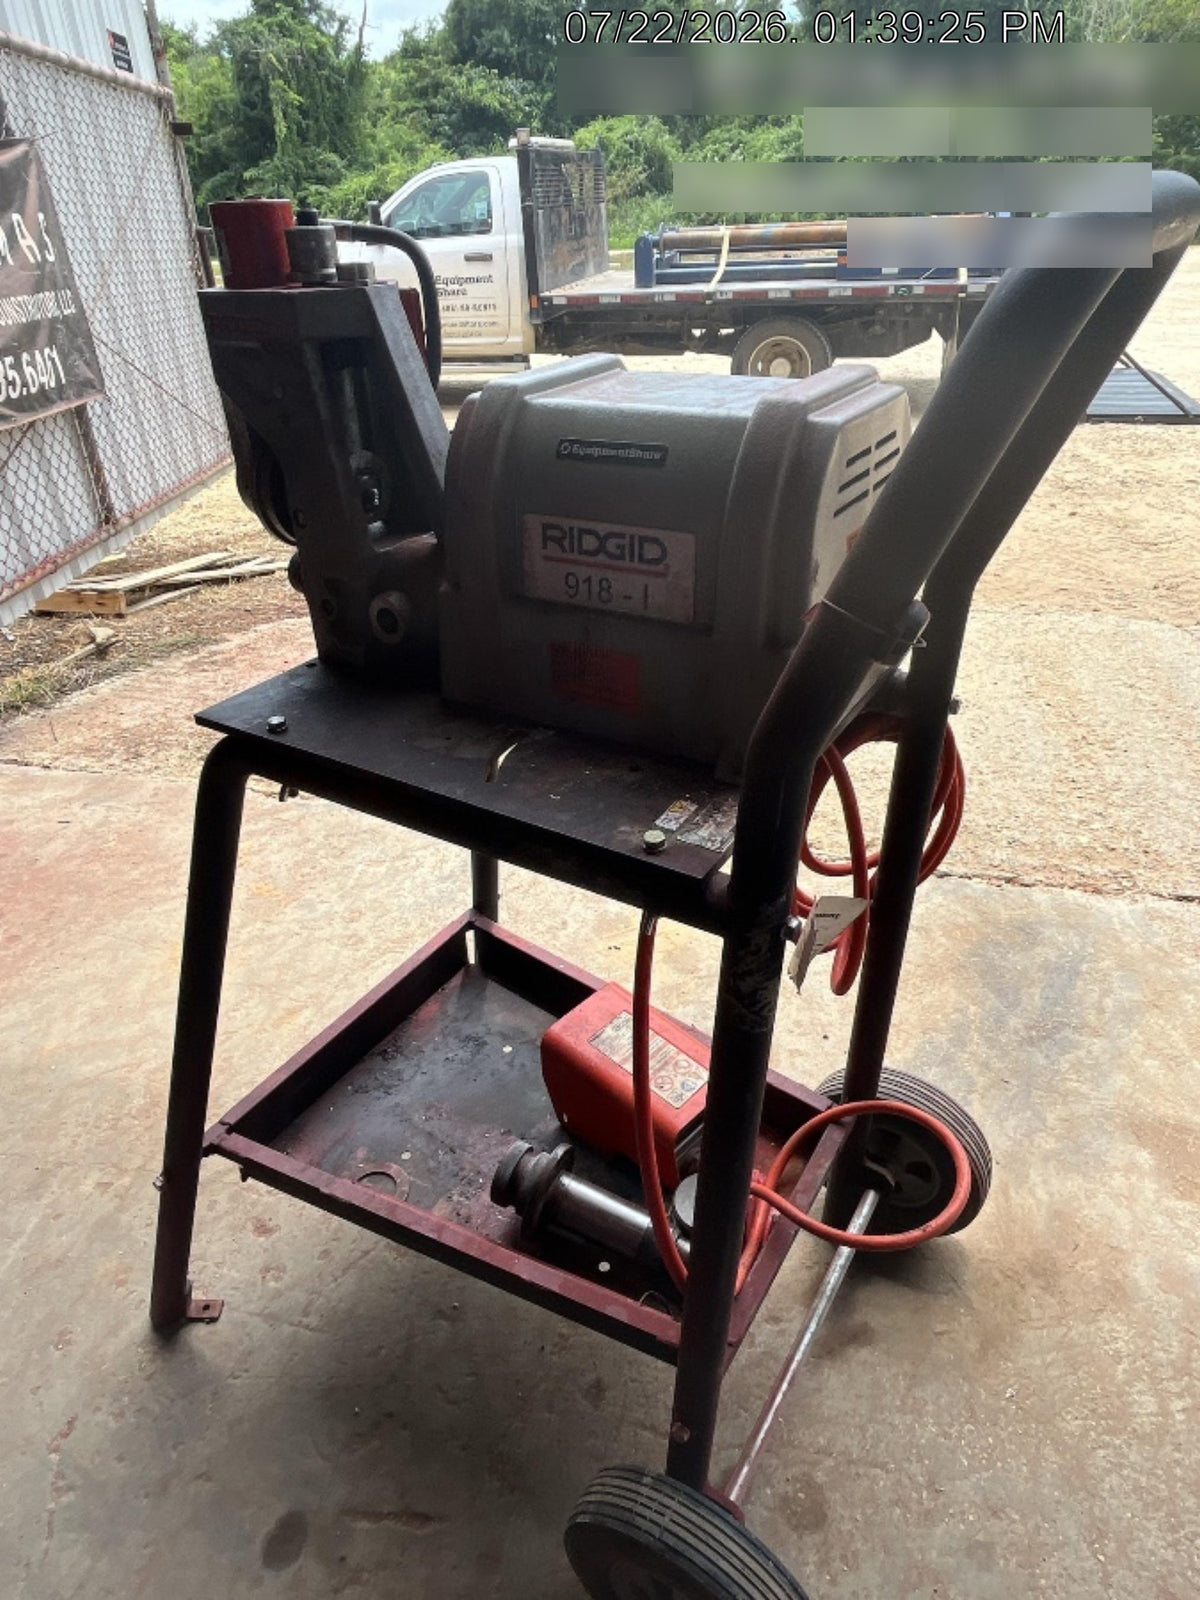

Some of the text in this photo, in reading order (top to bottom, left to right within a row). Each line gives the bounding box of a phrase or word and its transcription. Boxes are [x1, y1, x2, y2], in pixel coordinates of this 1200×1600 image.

[435, 275, 494, 287] Equipment
[436, 287, 467, 296] Share
[541, 522, 667, 566] RIDGID
[565, 572, 614, 604] 918
